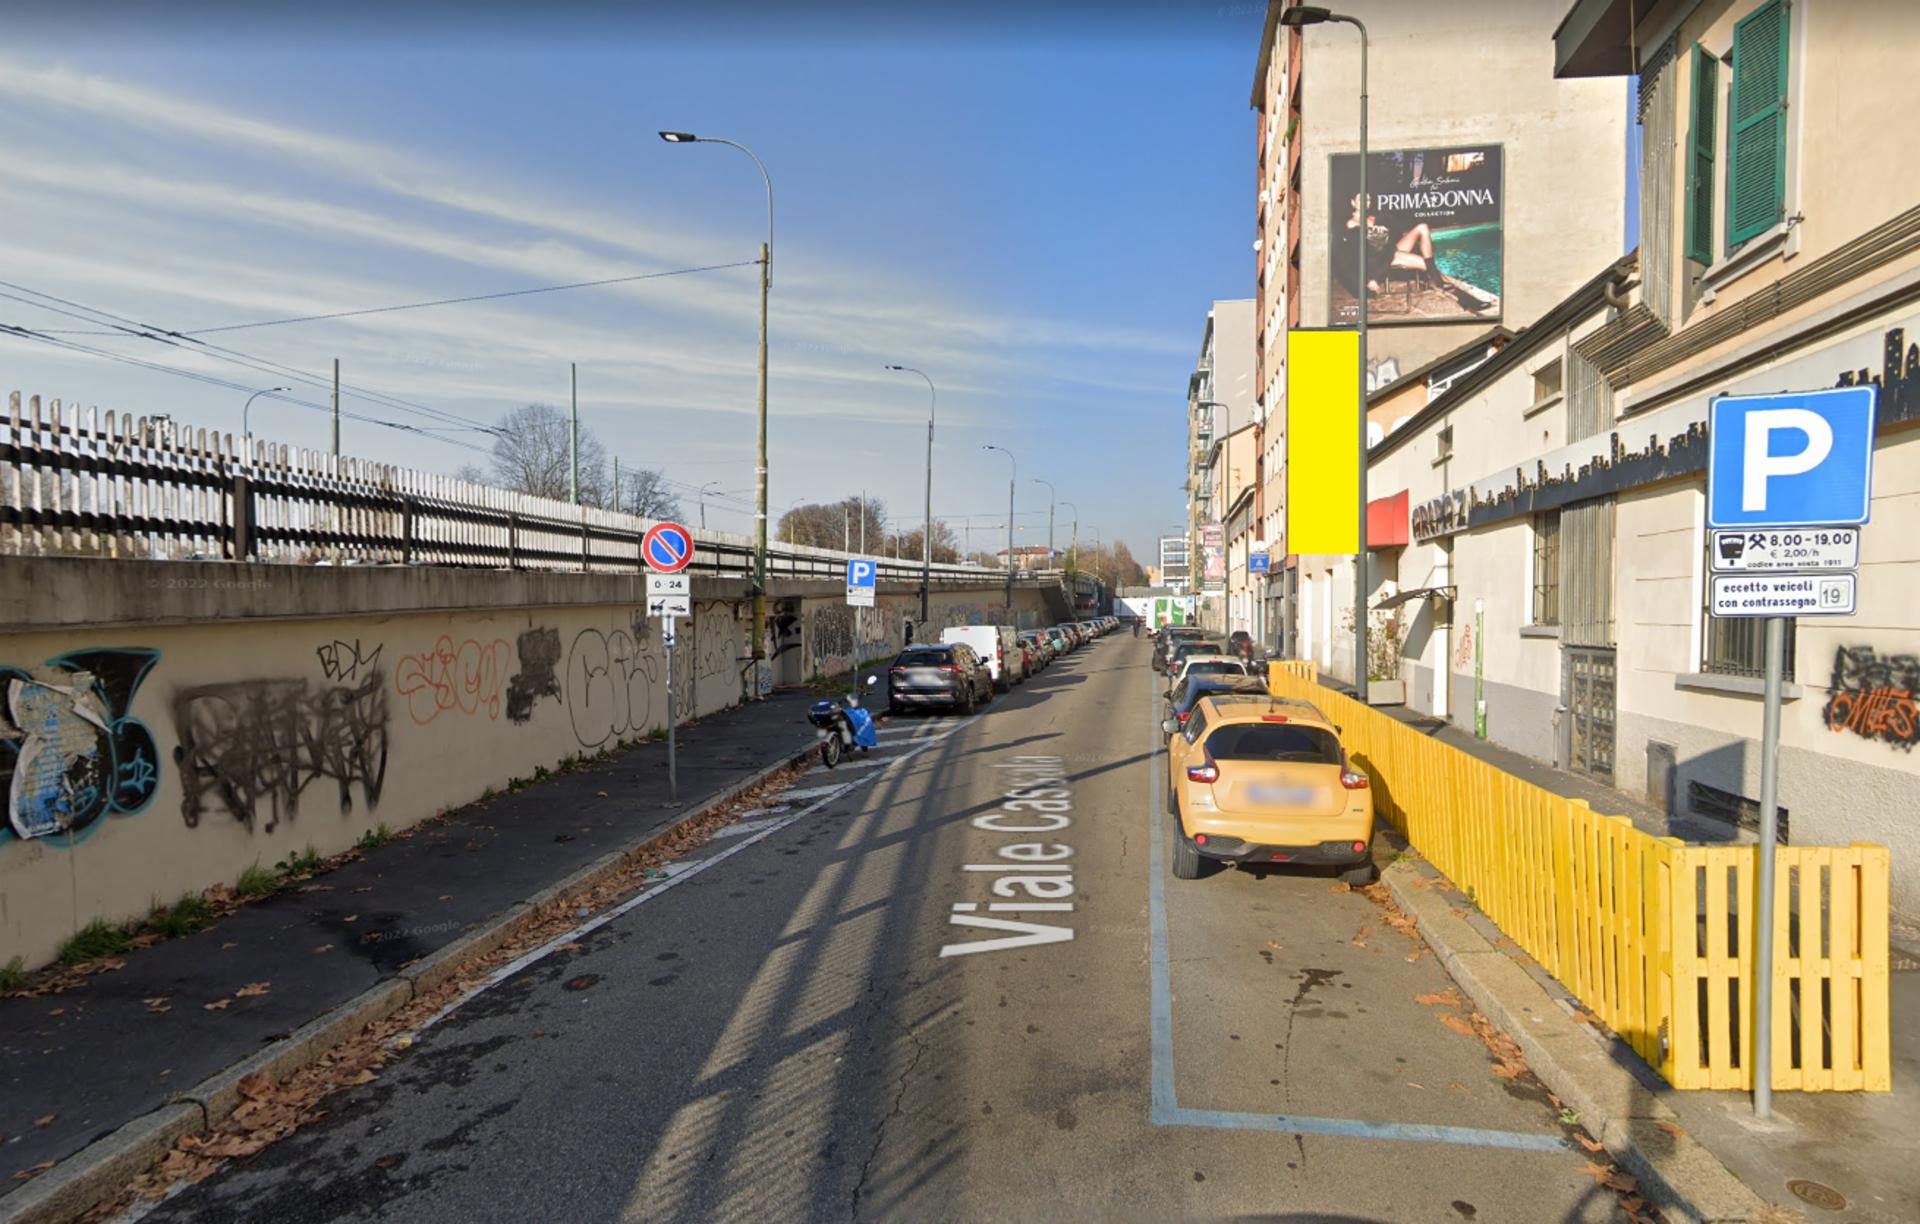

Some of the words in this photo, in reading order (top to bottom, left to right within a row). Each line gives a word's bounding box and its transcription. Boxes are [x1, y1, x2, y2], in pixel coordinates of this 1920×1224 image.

[1377, 188, 1494, 211] PRIMADONNA
[1742, 408, 1834, 512] P
[853, 562, 870, 584] P
[669, 580, 683, 589] 24
[1723, 581, 1768, 593] eccetto
[1772, 580, 1813, 592] veicoli
[1718, 598, 1738, 608] con
[1742, 596, 1817, 609] contrassegno
[1822, 587, 1841, 604] 19
